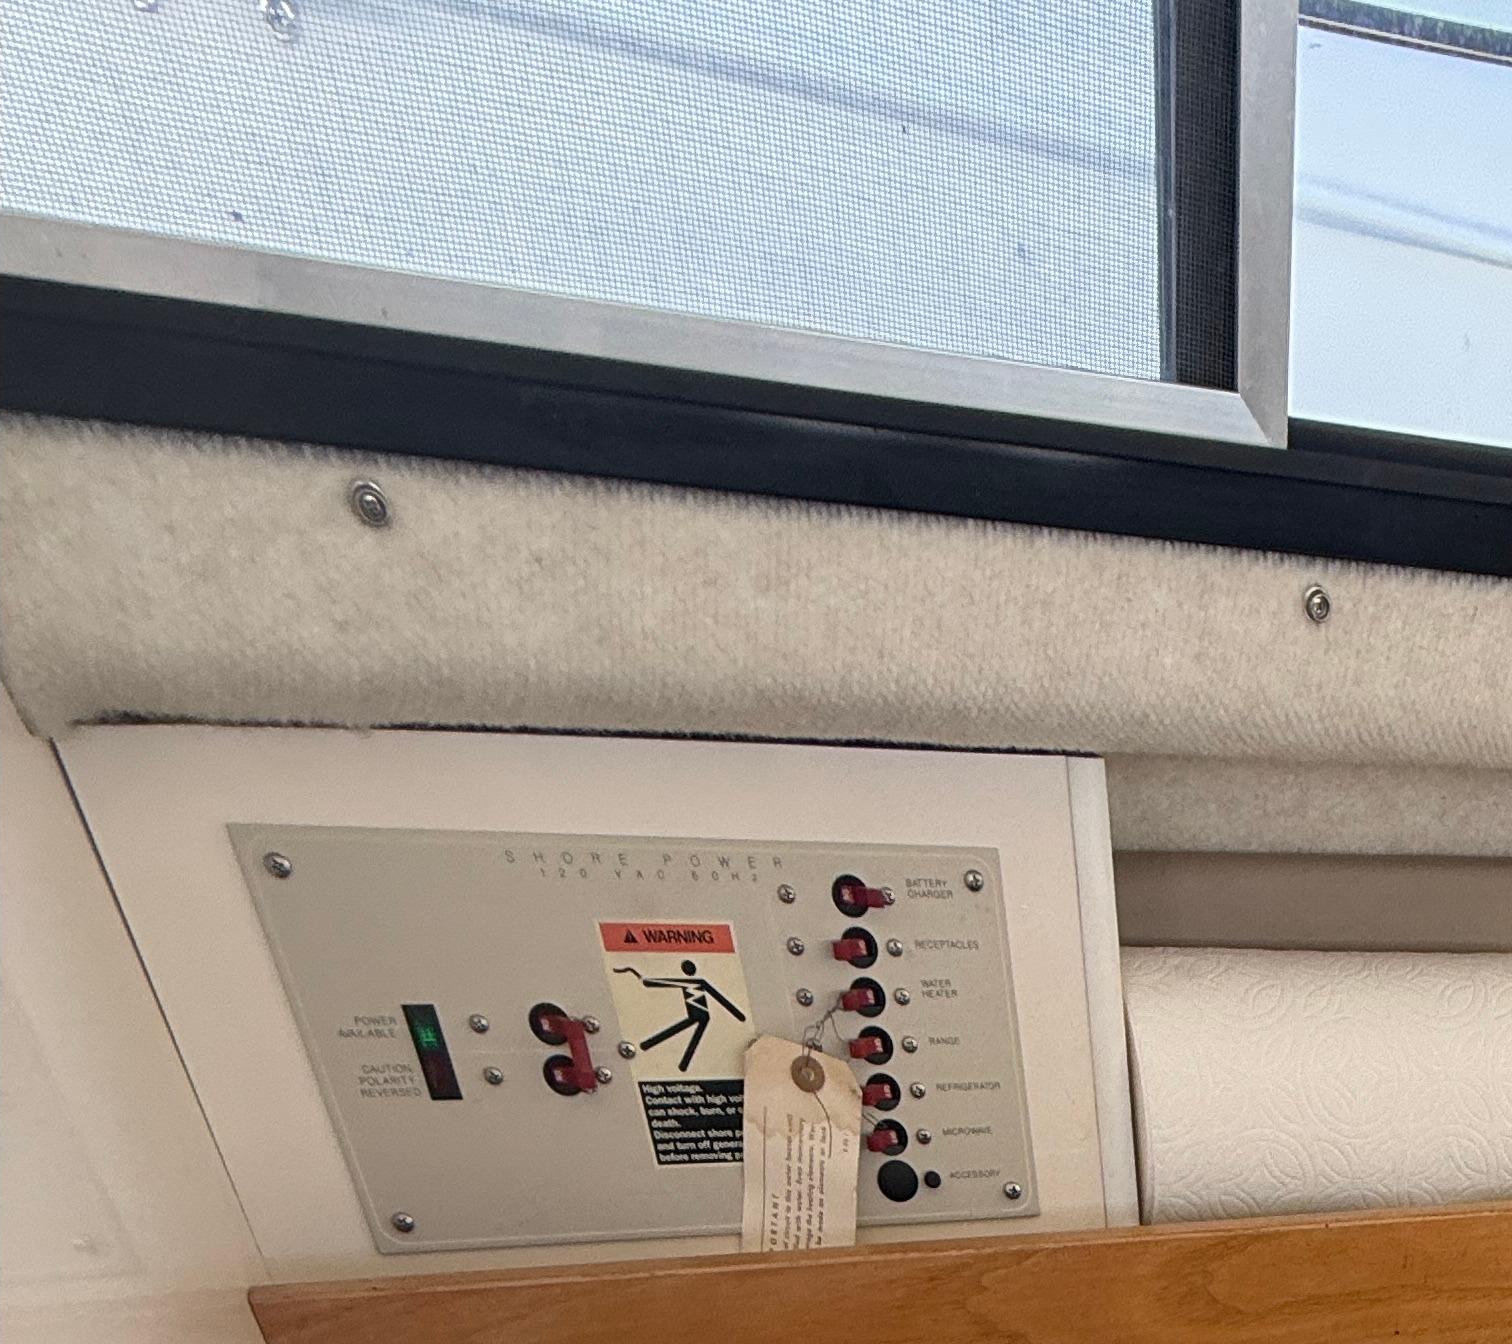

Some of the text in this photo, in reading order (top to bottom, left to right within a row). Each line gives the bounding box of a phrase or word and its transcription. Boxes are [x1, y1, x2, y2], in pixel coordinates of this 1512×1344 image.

[504, 850, 784, 869] SHORE POWER
[906, 878, 947, 887] BATTERY
[908, 889, 953, 899] CHARGER
[643, 930, 714, 944] WARNING
[914, 940, 979, 950] RECEPTACLES
[920, 979, 951, 988] WATER
[922, 990, 957, 998] HEATER
[354, 1016, 397, 1025] POWER
[338, 1028, 396, 1038] AVAILABLE
[928, 1036, 960, 1046] RANGE
[358, 1076, 416, 1086] POLARITY
[642, 1084, 664, 1095] High
[936, 1082, 1000, 1092] REFRIGERATOR
[360, 1088, 422, 1097] REVERSED
[646, 1096, 682, 1105] Contact
[683, 1095, 706, 1104] with
[706, 1094, 727, 1105] high
[726, 1107, 736, 1115] or
[654, 1130, 706, 1139] Disconnect
[708, 1128, 733, 1138] shore
[942, 1126, 992, 1136] MICROWAVE
[657, 1142, 675, 1150] and
[675, 1142, 696, 1150] turn
[697, 1140, 711, 1149] off
[658, 1152, 688, 1161] before
[690, 1152, 733, 1161] removing
[950, 1170, 1000, 1179] ACCESSORY
